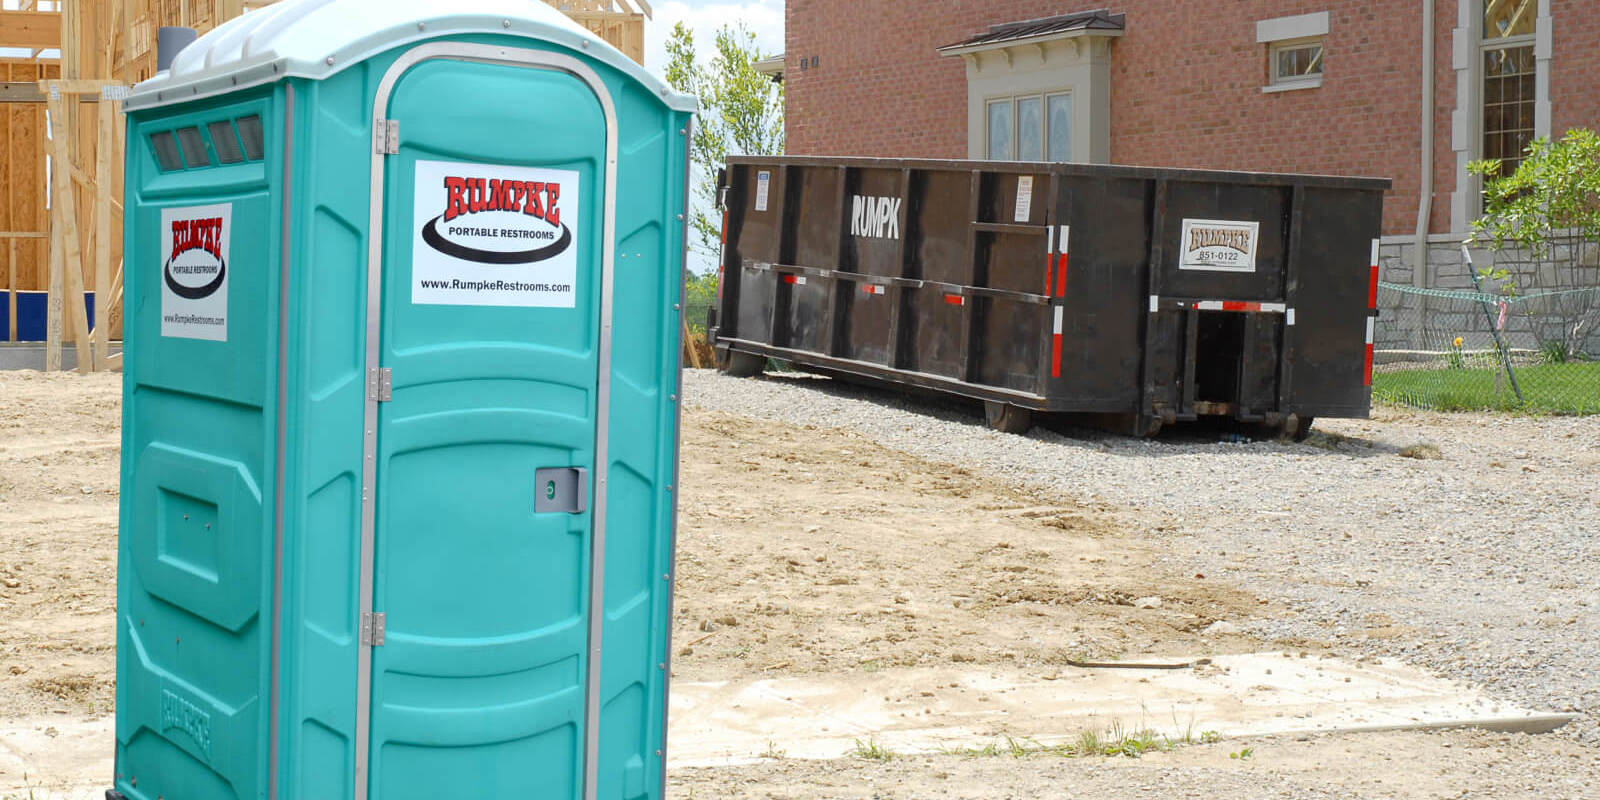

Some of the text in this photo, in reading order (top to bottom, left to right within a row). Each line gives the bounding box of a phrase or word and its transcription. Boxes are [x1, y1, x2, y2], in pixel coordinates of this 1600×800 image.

[444, 176, 560, 228] RUMPKE
[171, 217, 223, 262] RUMPKE
[449, 227, 555, 240] PORTABLE RESTROOMS
[1189, 228, 1249, 255] RUMPKE
[1200, 250, 1239, 260] 851-0122
[173, 265, 218, 274] PORTABLE RESTROOMS
[421, 279, 571, 292] www.RumpkeRestrooms.com
